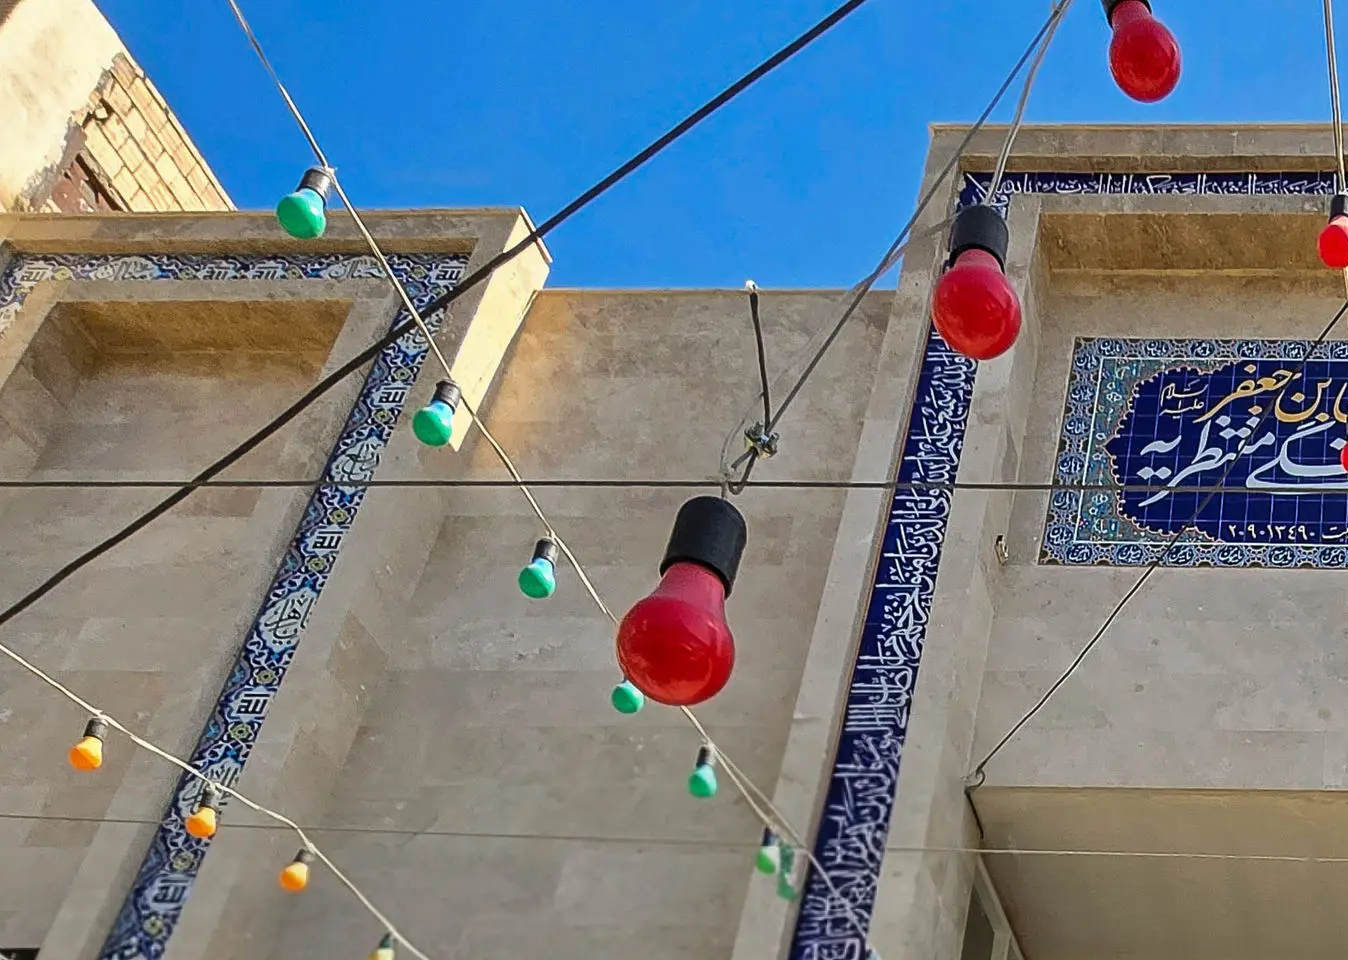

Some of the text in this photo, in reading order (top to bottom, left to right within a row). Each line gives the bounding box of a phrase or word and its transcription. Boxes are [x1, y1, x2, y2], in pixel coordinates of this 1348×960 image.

[1198, 363, 1303, 424] جعفر
[1275, 373, 1332, 424] بن
[1138, 415, 1276, 507] منتظریه
